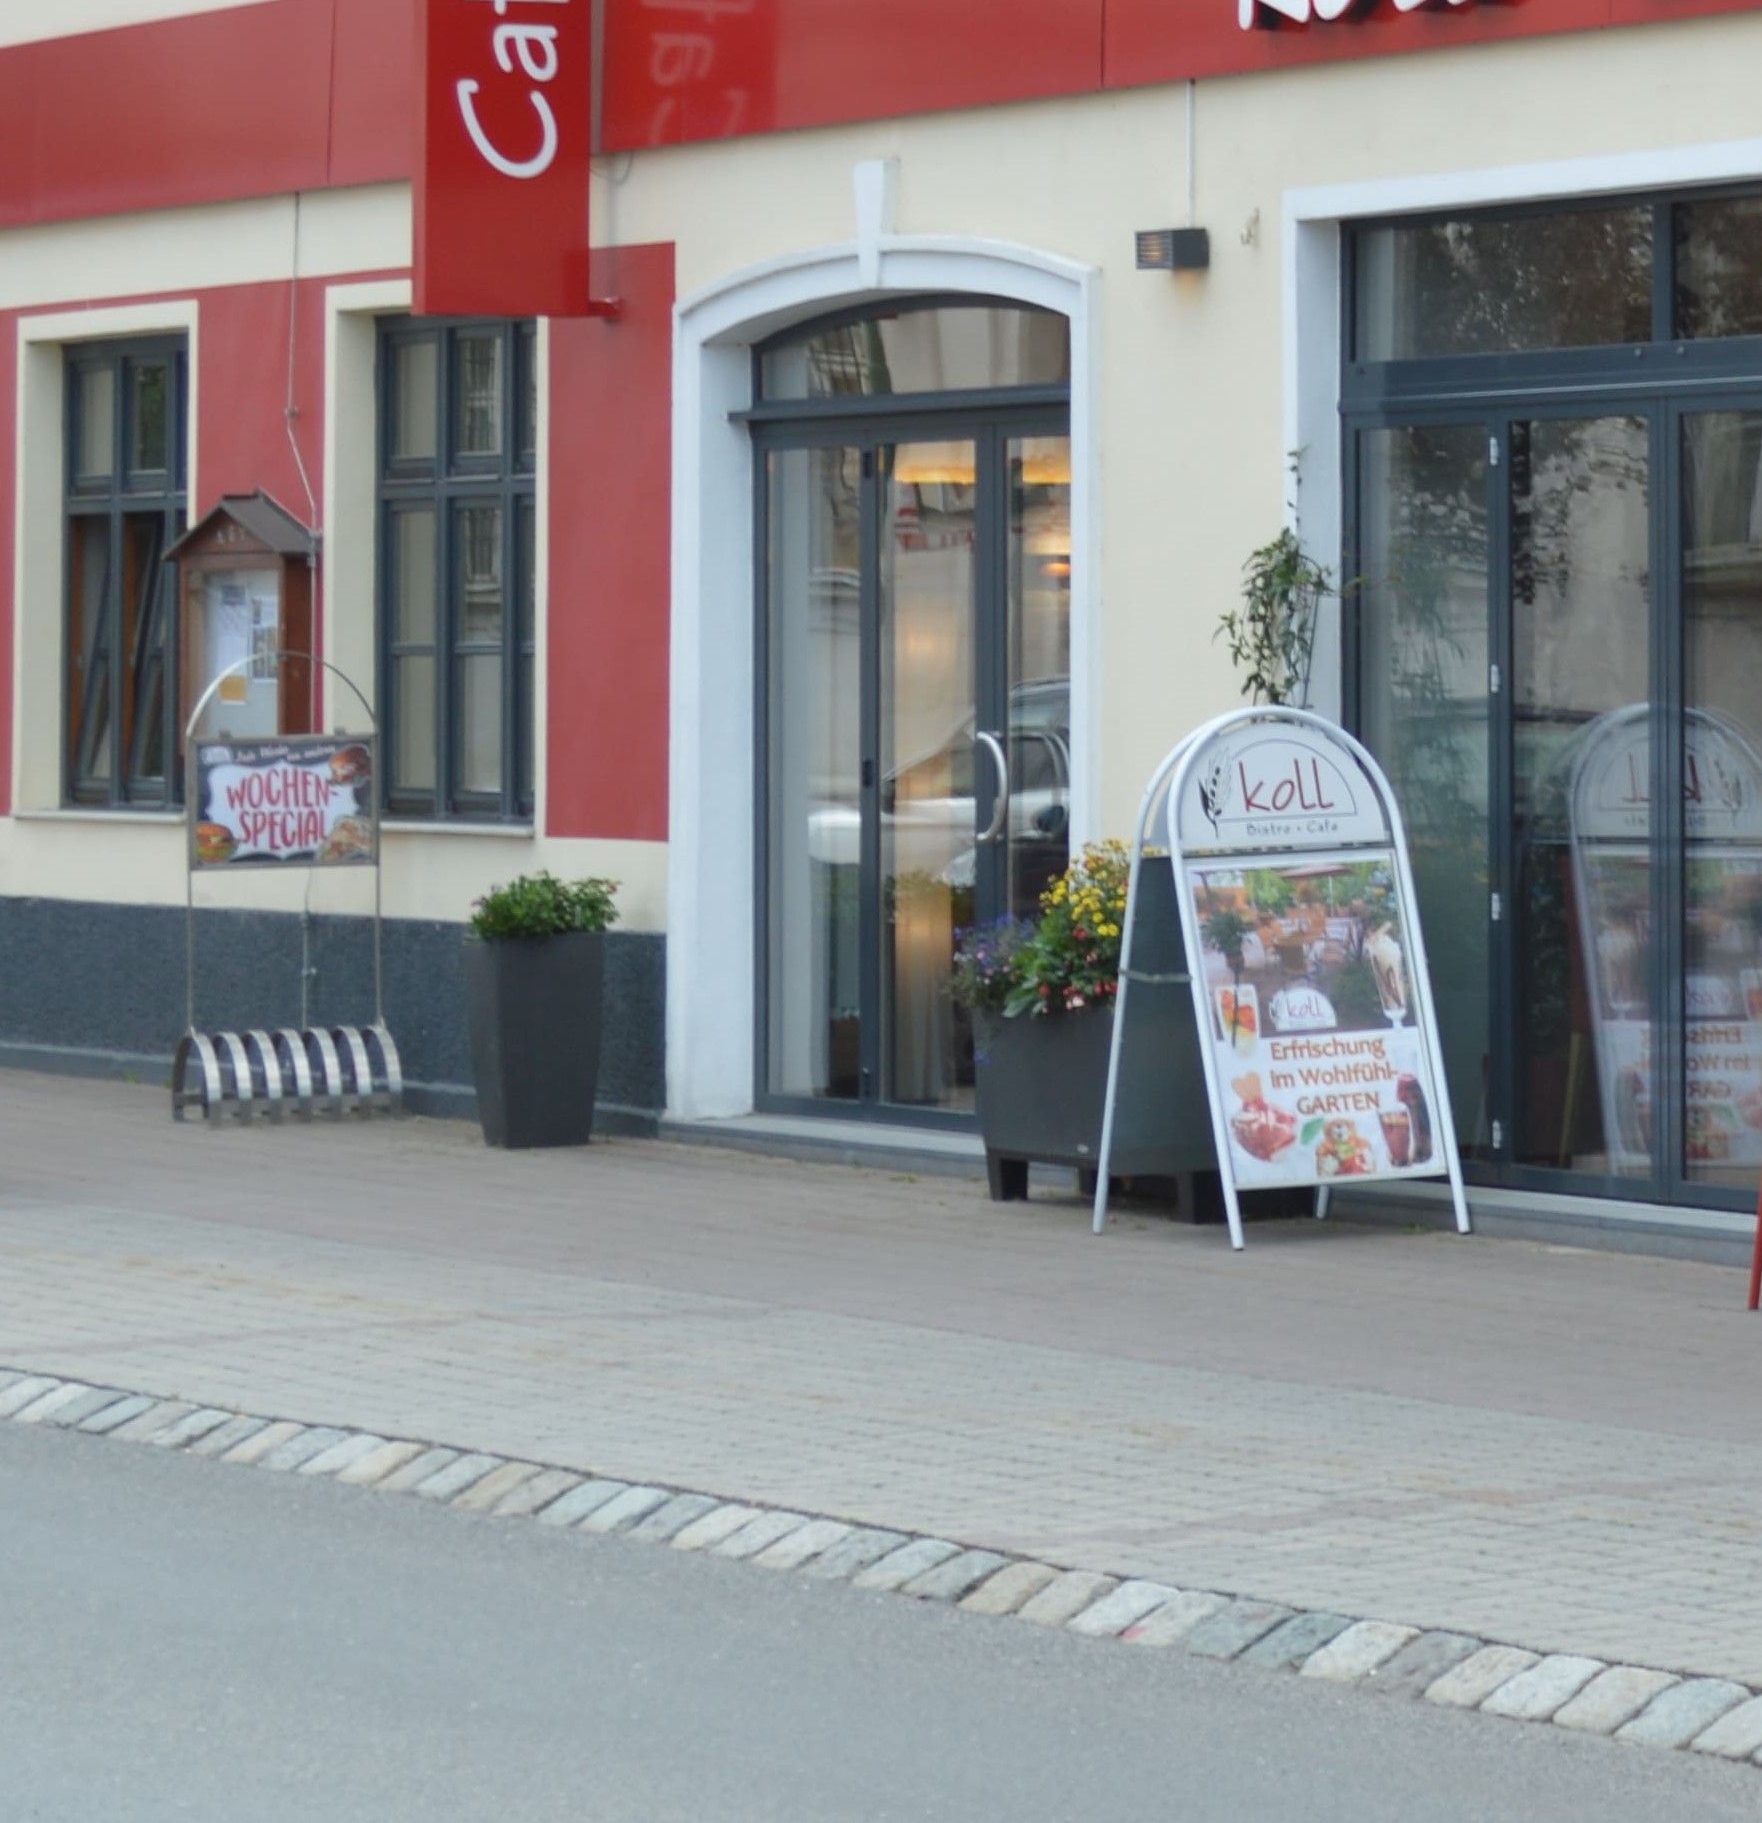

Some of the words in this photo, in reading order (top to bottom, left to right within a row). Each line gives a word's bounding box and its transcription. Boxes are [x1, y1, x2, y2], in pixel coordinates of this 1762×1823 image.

[227, 768, 338, 810] WOCHEN-
[1238, 756, 1335, 812] koll
[238, 810, 328, 851] SPECIAL
[1270, 1037, 1386, 1061] Erfrischung
[1299, 1061, 1399, 1086] Wohlfühl-
[1296, 1091, 1380, 1115] GARTEN
